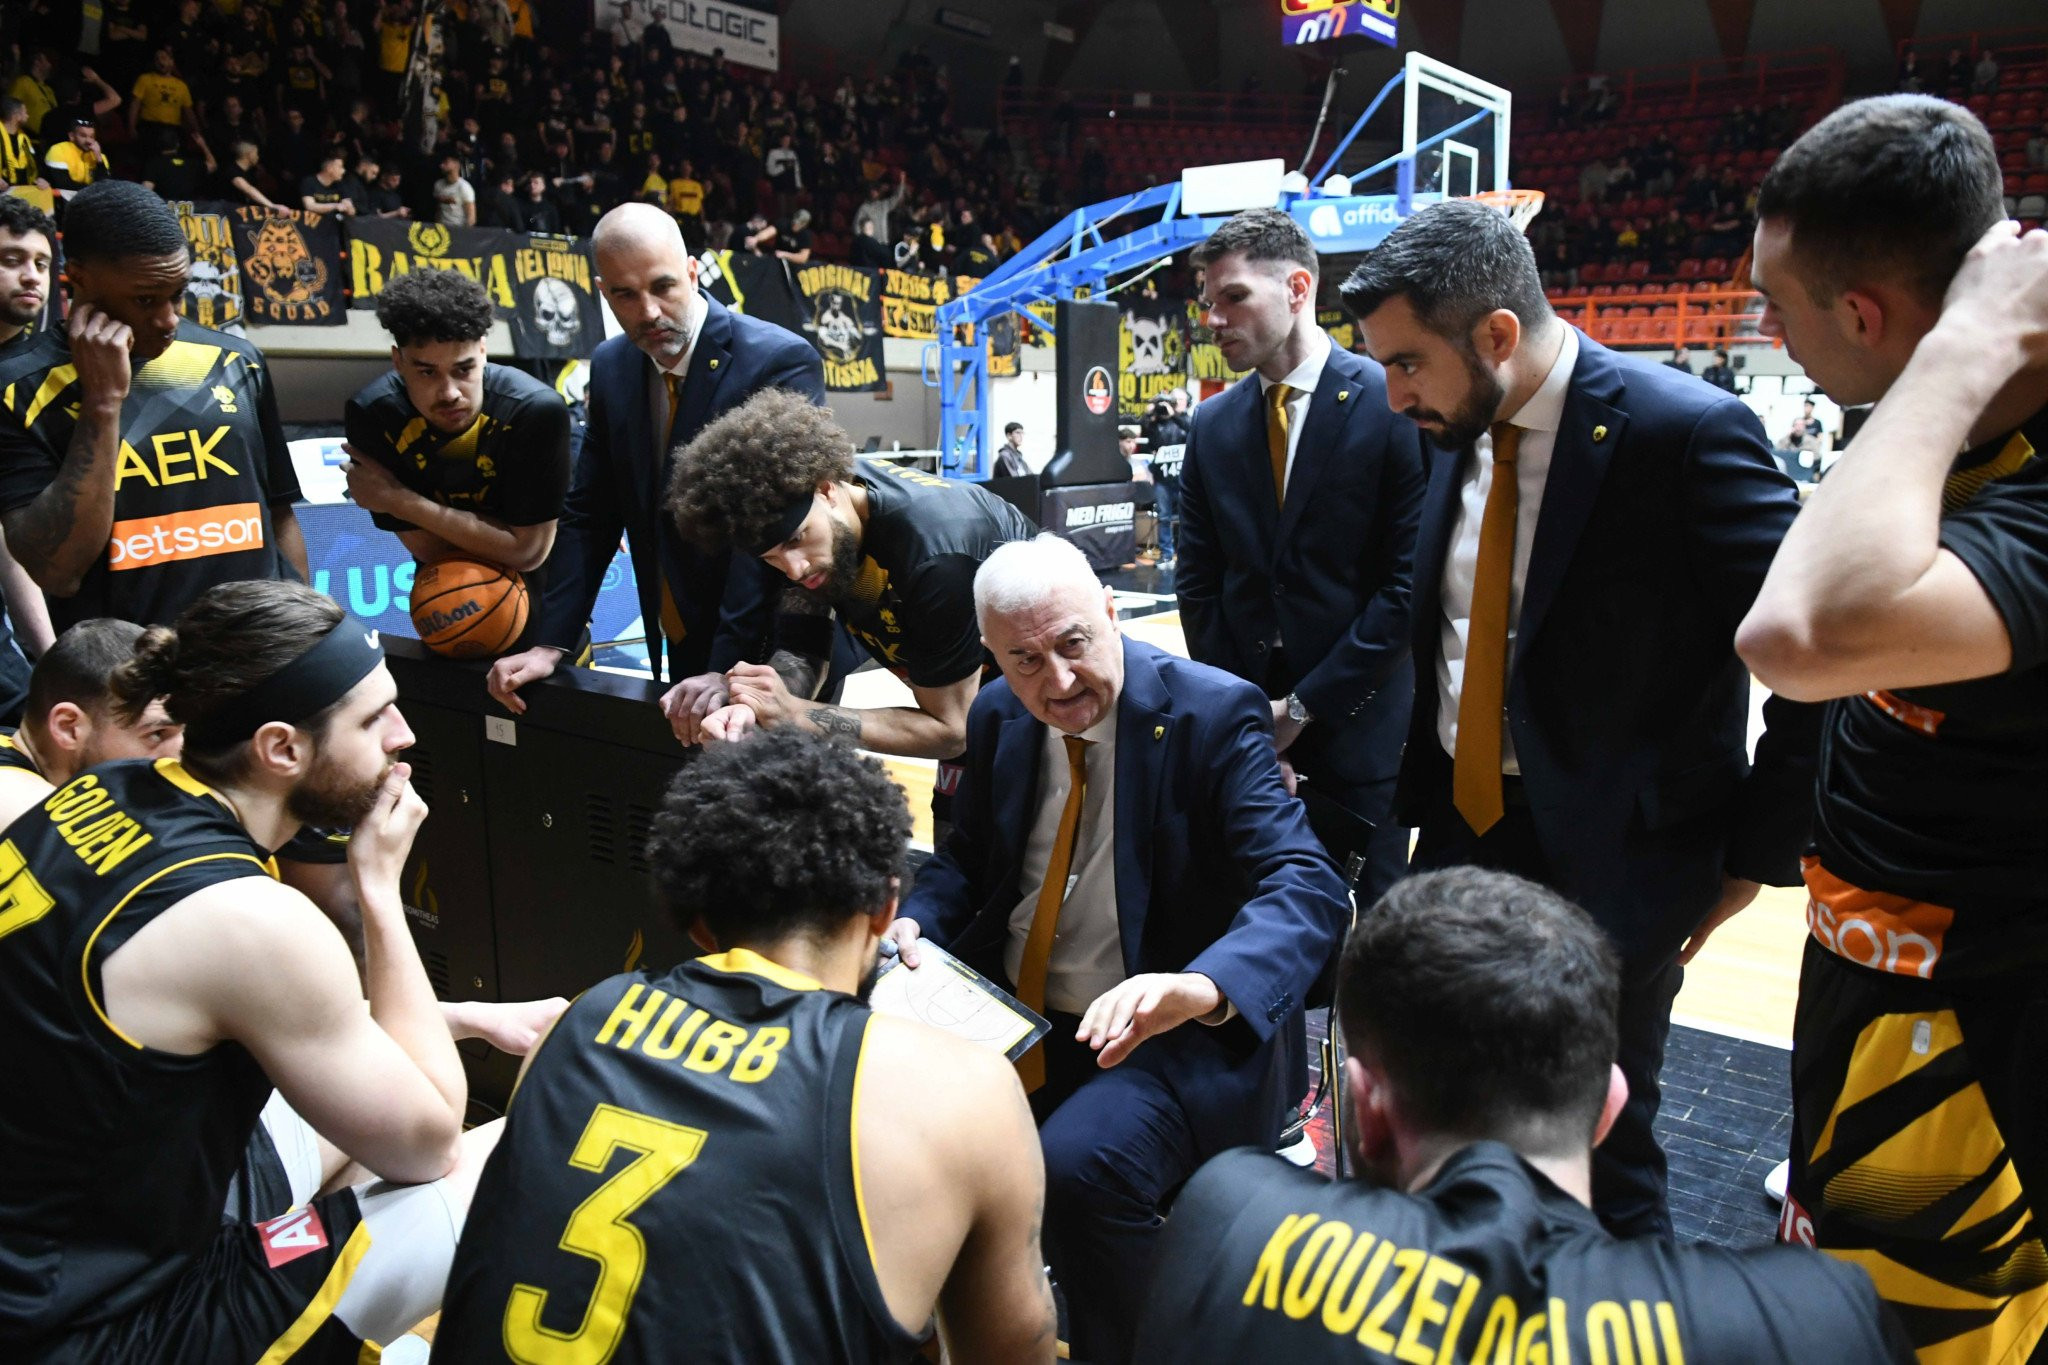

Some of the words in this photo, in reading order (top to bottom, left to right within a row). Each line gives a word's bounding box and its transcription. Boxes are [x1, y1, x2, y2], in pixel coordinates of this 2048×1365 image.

[236, 205, 323, 229] YELOW
[797, 264, 871, 303] ORIGINAL
[253, 296, 331, 321] SQUAD
[822, 357, 879, 388] TISSIA
[115, 425, 239, 491] AEK
[416, 598, 482, 639] Wilson
[44, 774, 154, 876] GOLDEN
[594, 982, 791, 1084] HUBB
[502, 1102, 709, 1365] 3
